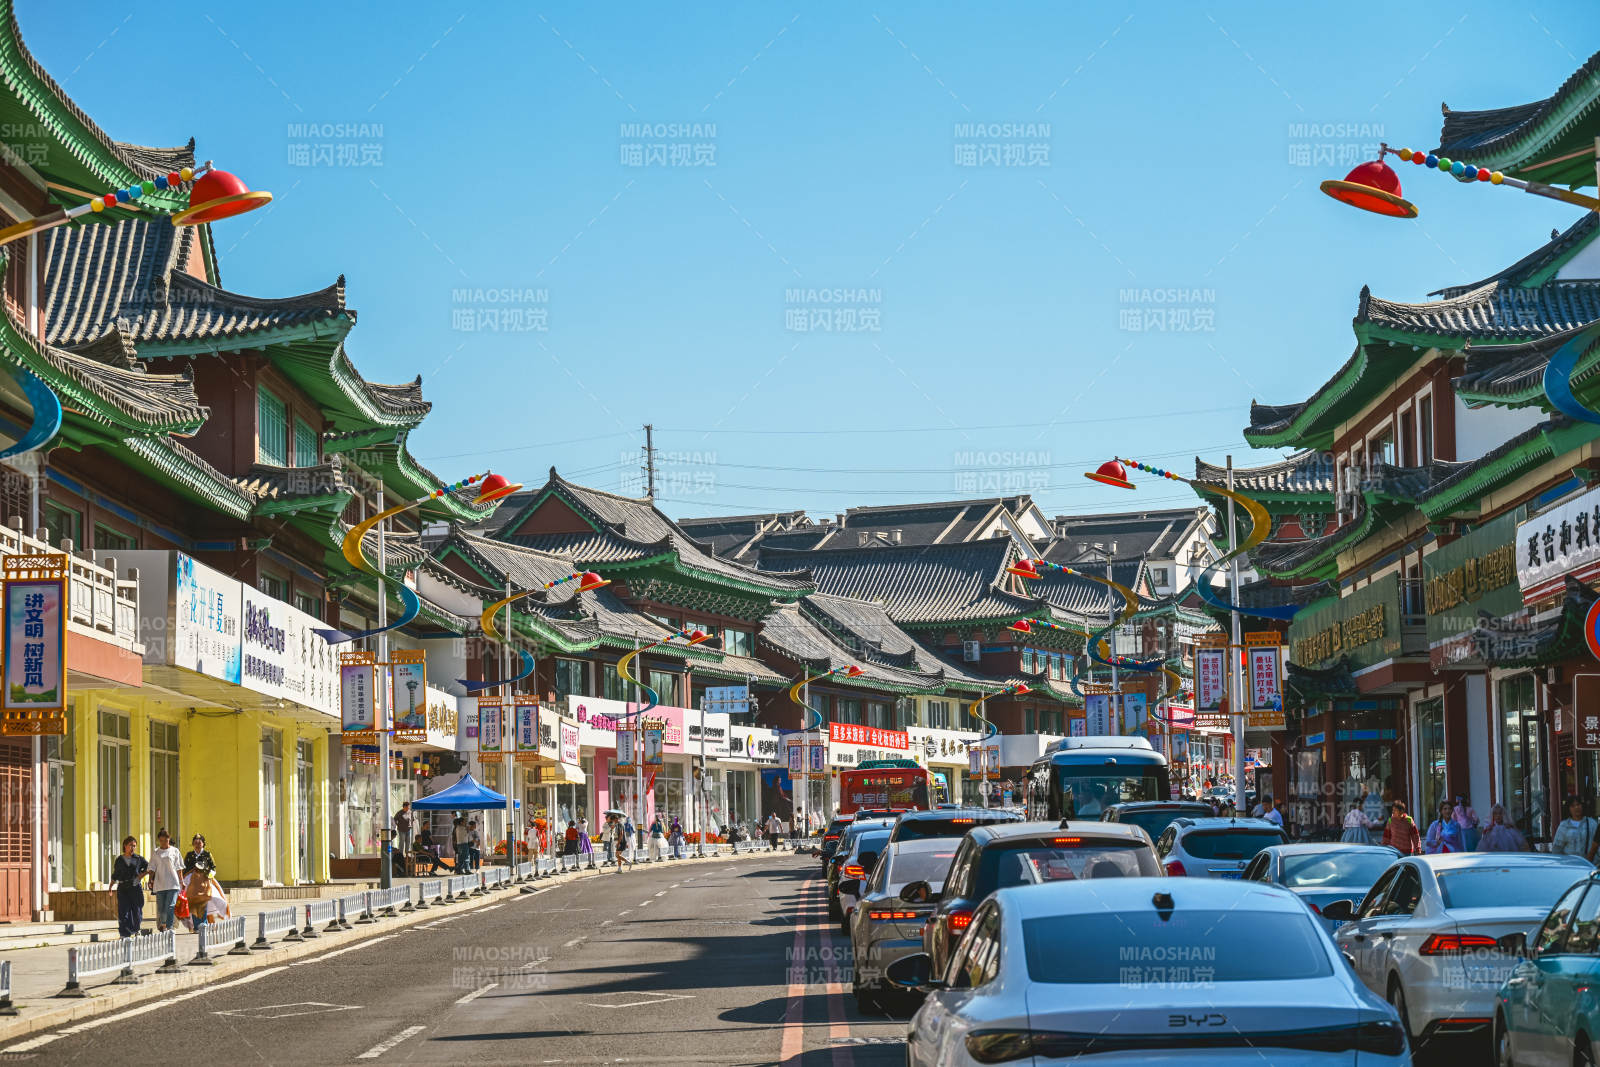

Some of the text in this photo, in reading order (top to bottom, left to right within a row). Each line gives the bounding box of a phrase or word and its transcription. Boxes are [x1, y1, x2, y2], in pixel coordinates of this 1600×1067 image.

[24, 593, 44, 688] 讲文明 树新风
[1256, 656, 1266, 703] 最美的打卡点
[1265, 656, 1274, 694] 让文明成为
[1585, 716, 1600, 730] 景
[1585, 733, 1600, 745] 관
[1168, 1014, 1228, 1027] BYD
